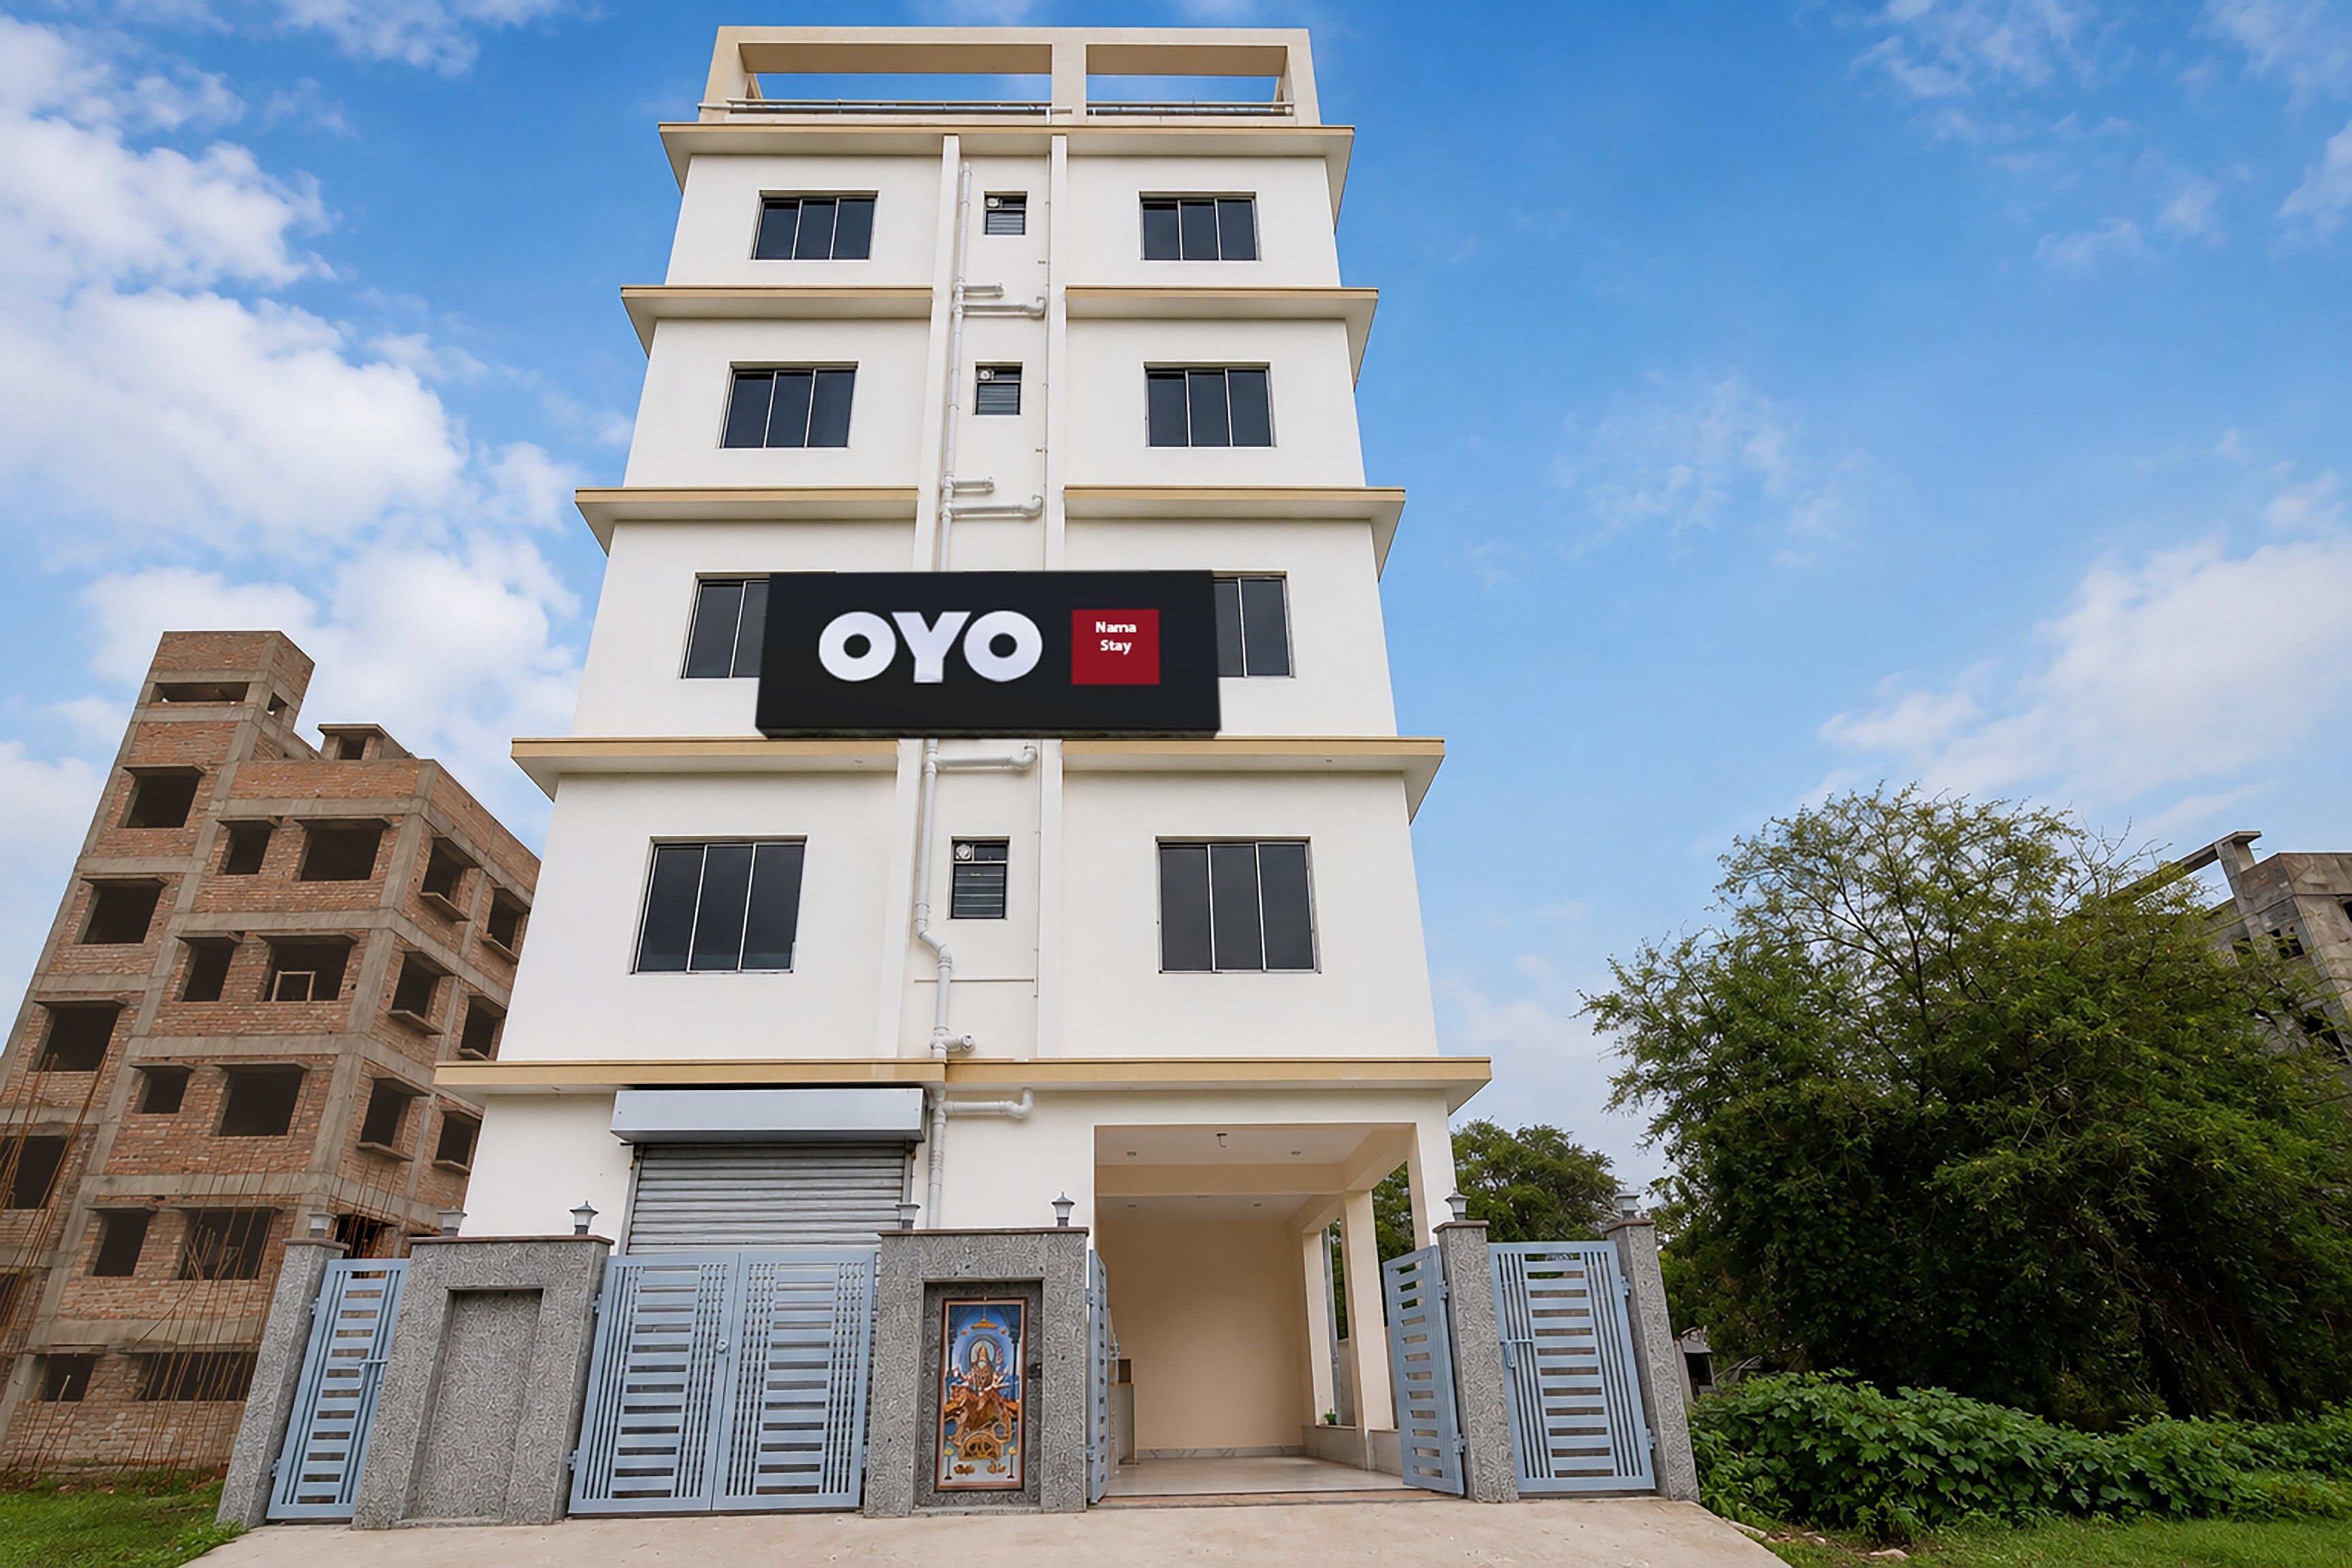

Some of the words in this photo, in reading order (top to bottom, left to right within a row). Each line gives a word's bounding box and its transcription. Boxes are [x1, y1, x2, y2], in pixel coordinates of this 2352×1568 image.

[1095, 621, 1137, 633] Nama
[819, 610, 1043, 683] OYO
[1100, 640, 1132, 655] Stay
